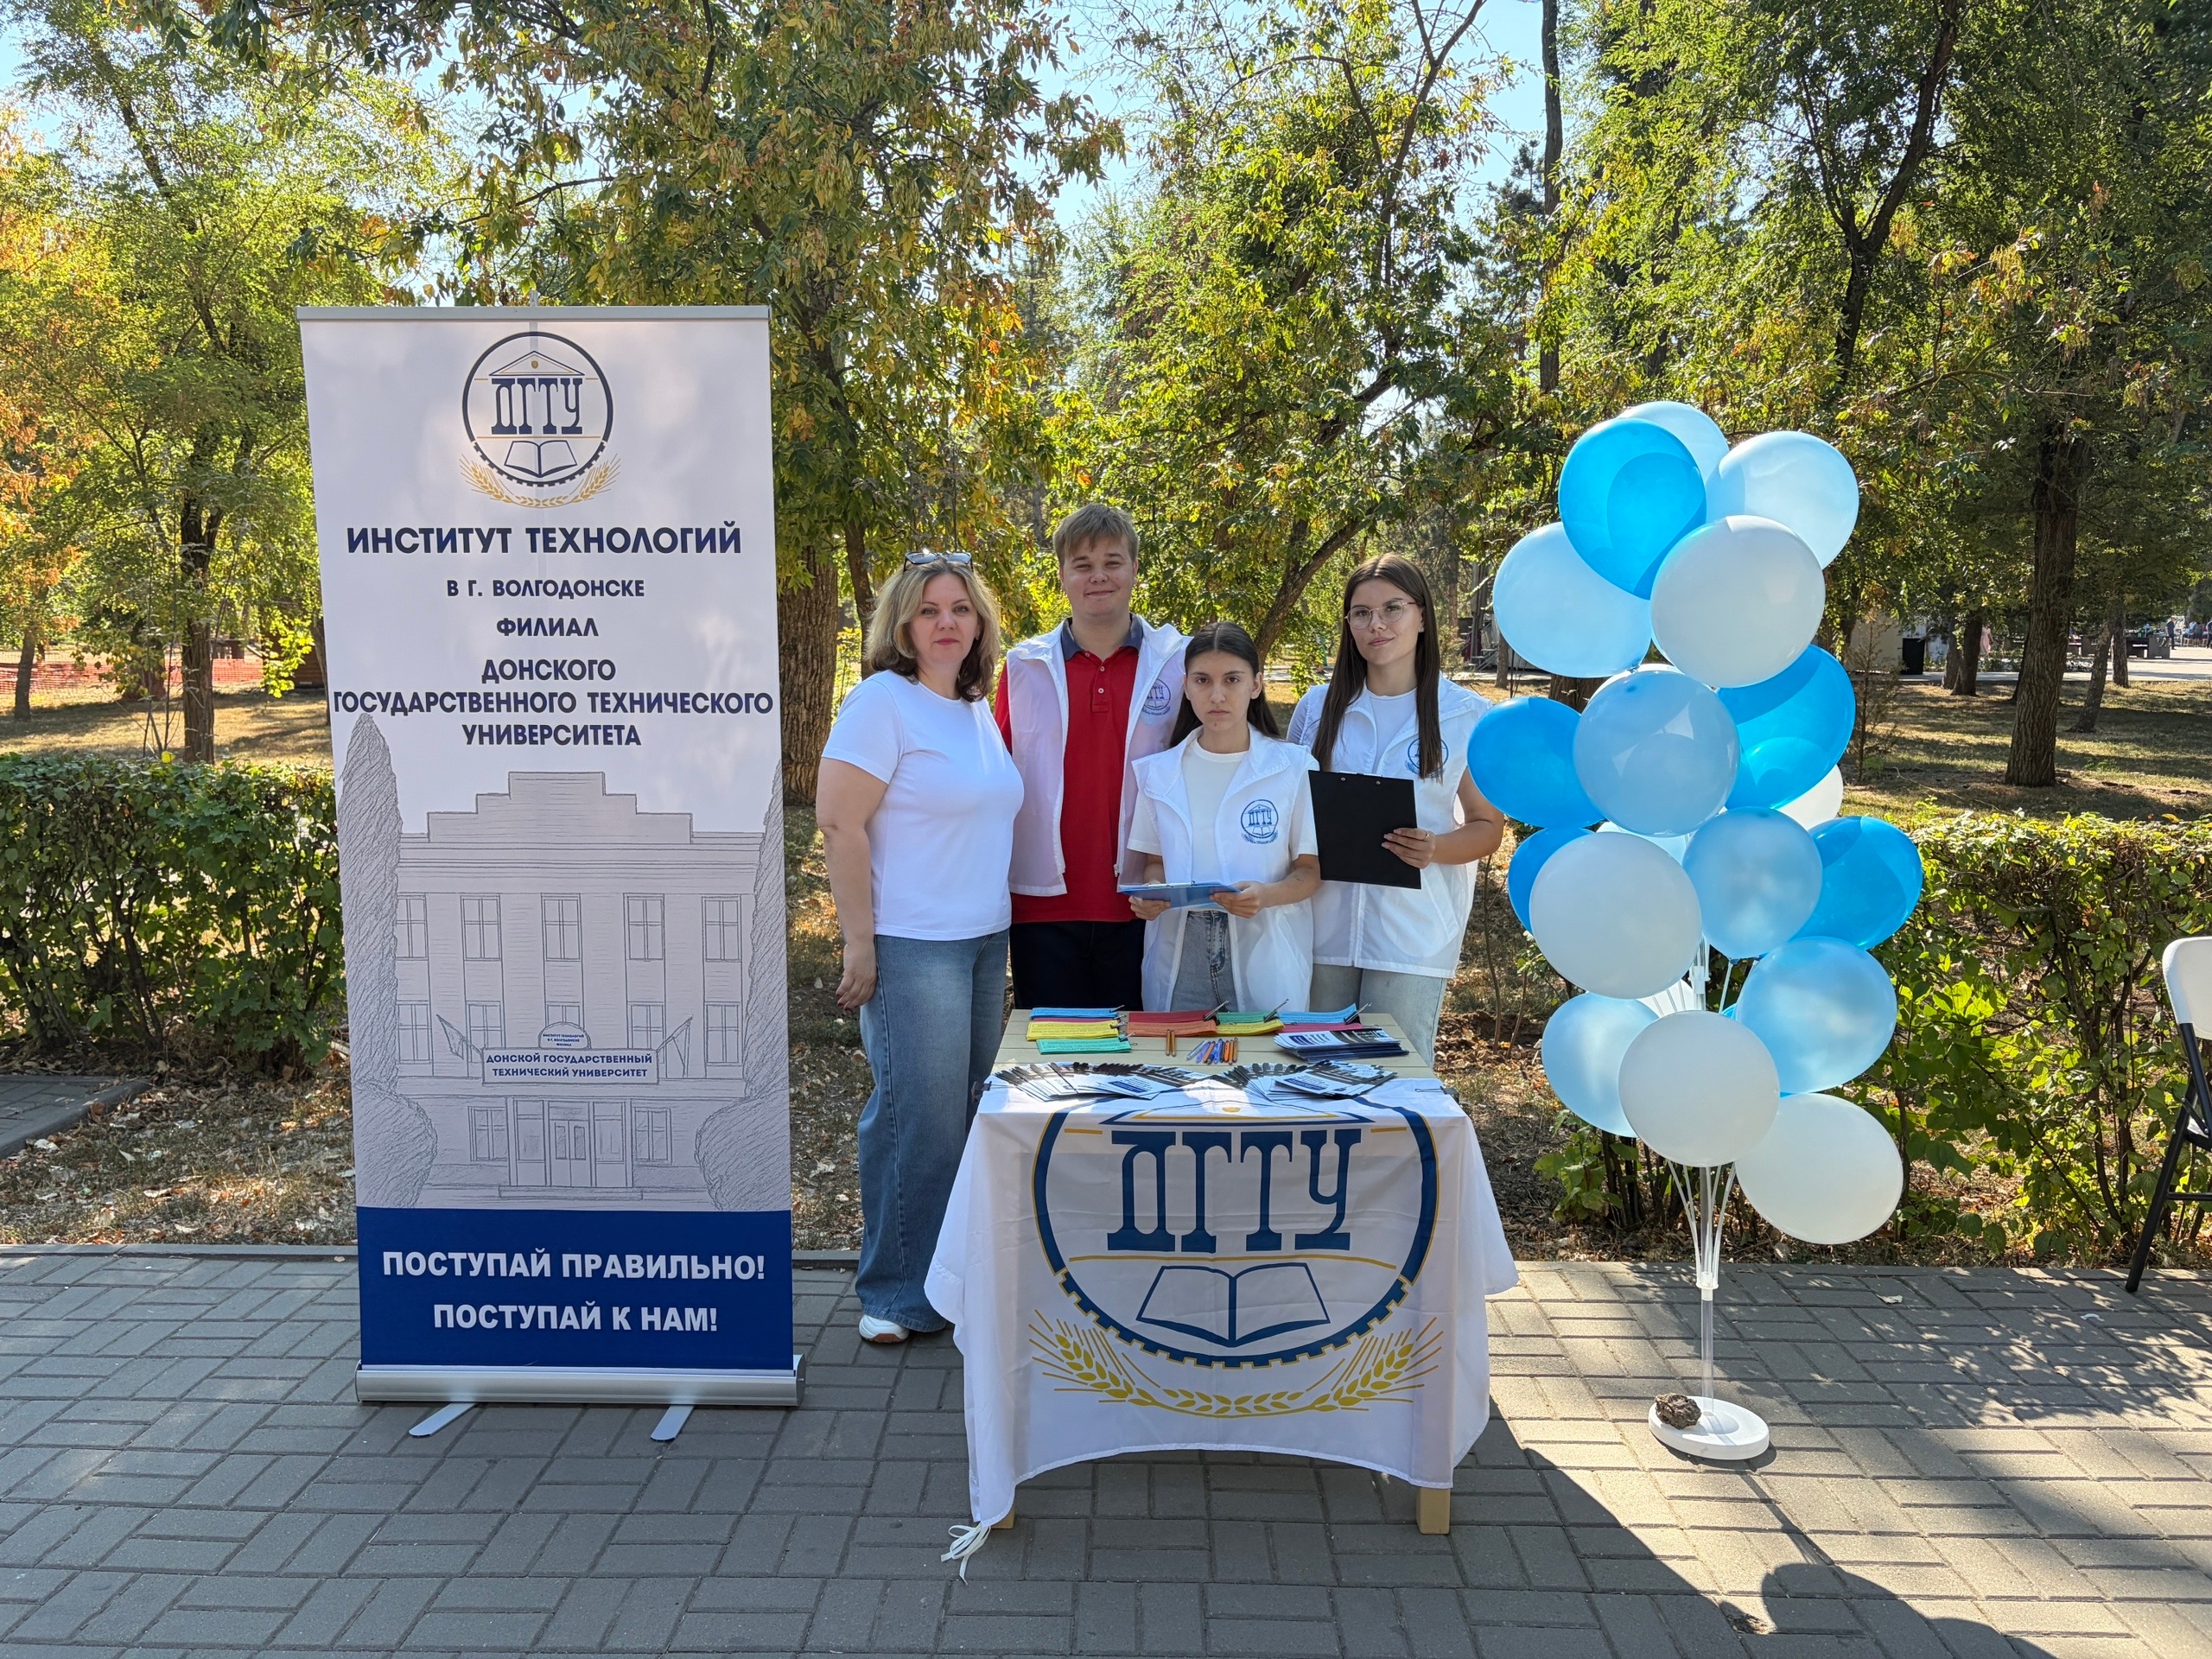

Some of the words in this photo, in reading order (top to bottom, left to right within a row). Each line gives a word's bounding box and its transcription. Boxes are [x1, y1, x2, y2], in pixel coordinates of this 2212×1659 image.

[491, 378, 582, 434] ДГТУ
[347, 528, 512, 553] ИНСТИТУТ
[525, 521, 741, 553] ТЕХНОЛОГИЙ
[448, 580, 459, 596] В
[468, 580, 482, 596] Г.
[493, 580, 644, 599] ВОЛГОДОНСКЕ
[497, 618, 599, 636] ФИЛИАЛ
[481, 659, 615, 683] ДОНСКОГО
[334, 691, 576, 715] ГОСУДАРСТВЕННОГО
[588, 692, 772, 714] ТЕХНИЧЕСКОГО
[1147, 686, 1165, 699] ГТУ
[462, 725, 641, 745] УНИВЕРСИТЕТА
[1248, 810, 1272, 826] ДГТУ
[486, 1052, 540, 1063] ДОНСКОЙ
[544, 1054, 652, 1064] ГОСУДАРСТВЕННЫЙ
[493, 1067, 569, 1077] ТЕХНИЧЕСКИЙ
[1107, 1128, 1362, 1253] ДГТУ
[384, 1248, 550, 1276] ПОСТУПАЙ
[563, 1254, 764, 1280] ПРАВИЛЬНО!
[435, 1301, 601, 1329] ПОСТУПАЙ
[613, 1307, 631, 1330] К
[641, 1307, 716, 1331] НАМ!
